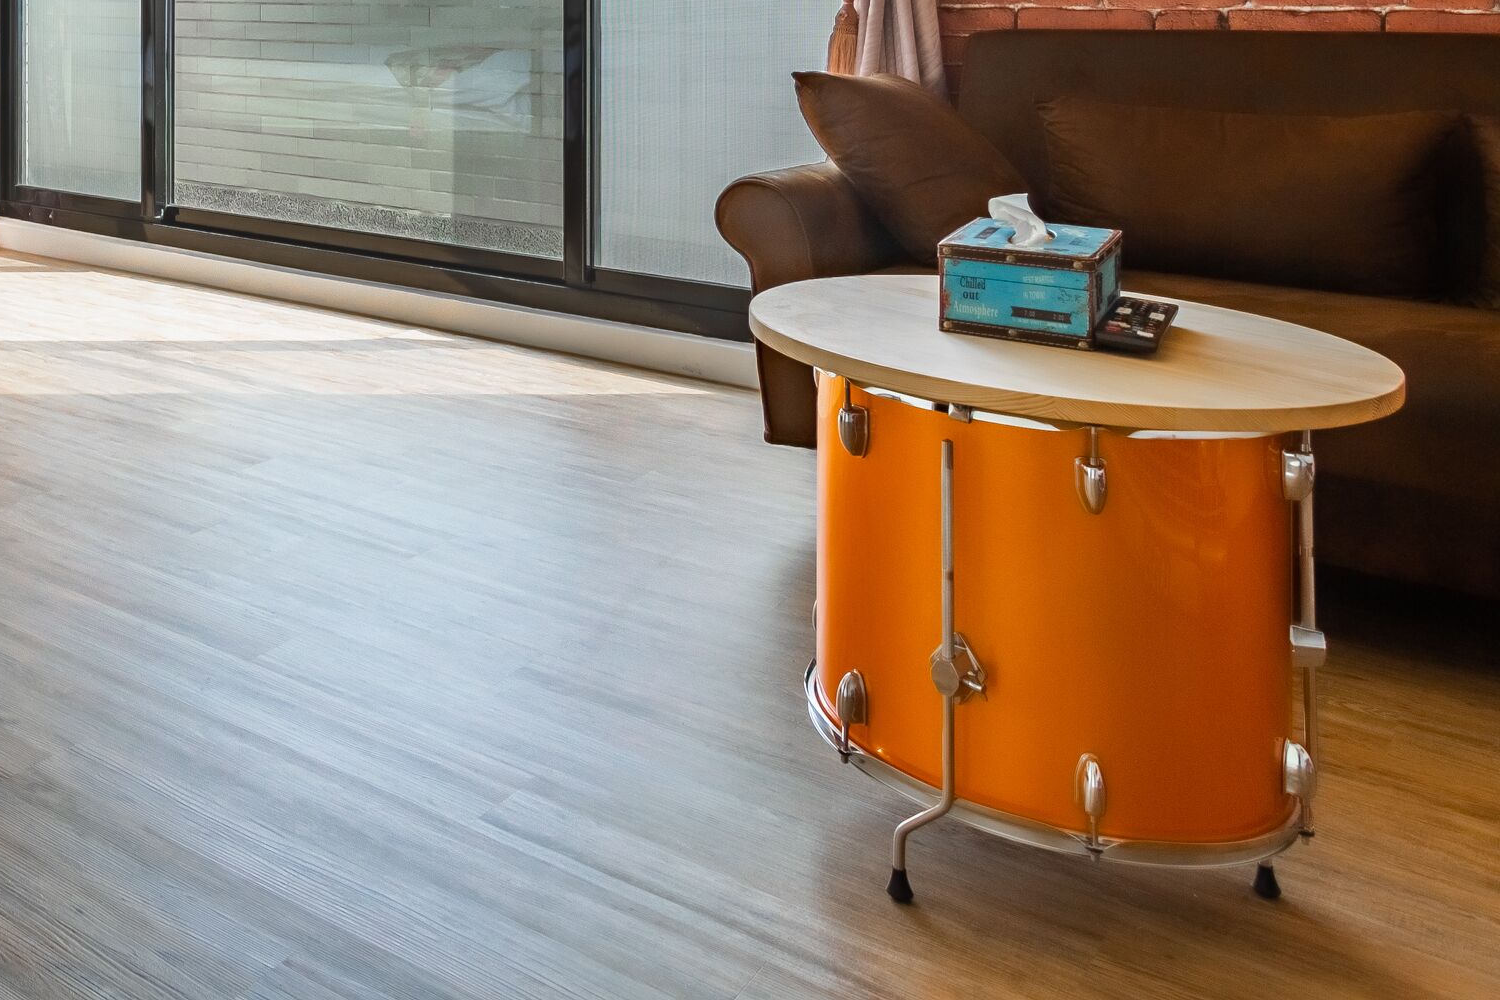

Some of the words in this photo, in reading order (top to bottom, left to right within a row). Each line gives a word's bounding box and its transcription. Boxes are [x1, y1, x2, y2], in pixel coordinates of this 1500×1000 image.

[959, 276, 986, 290] Chilled
[962, 290, 980, 300] out
[953, 300, 999, 319] Atmosphere
